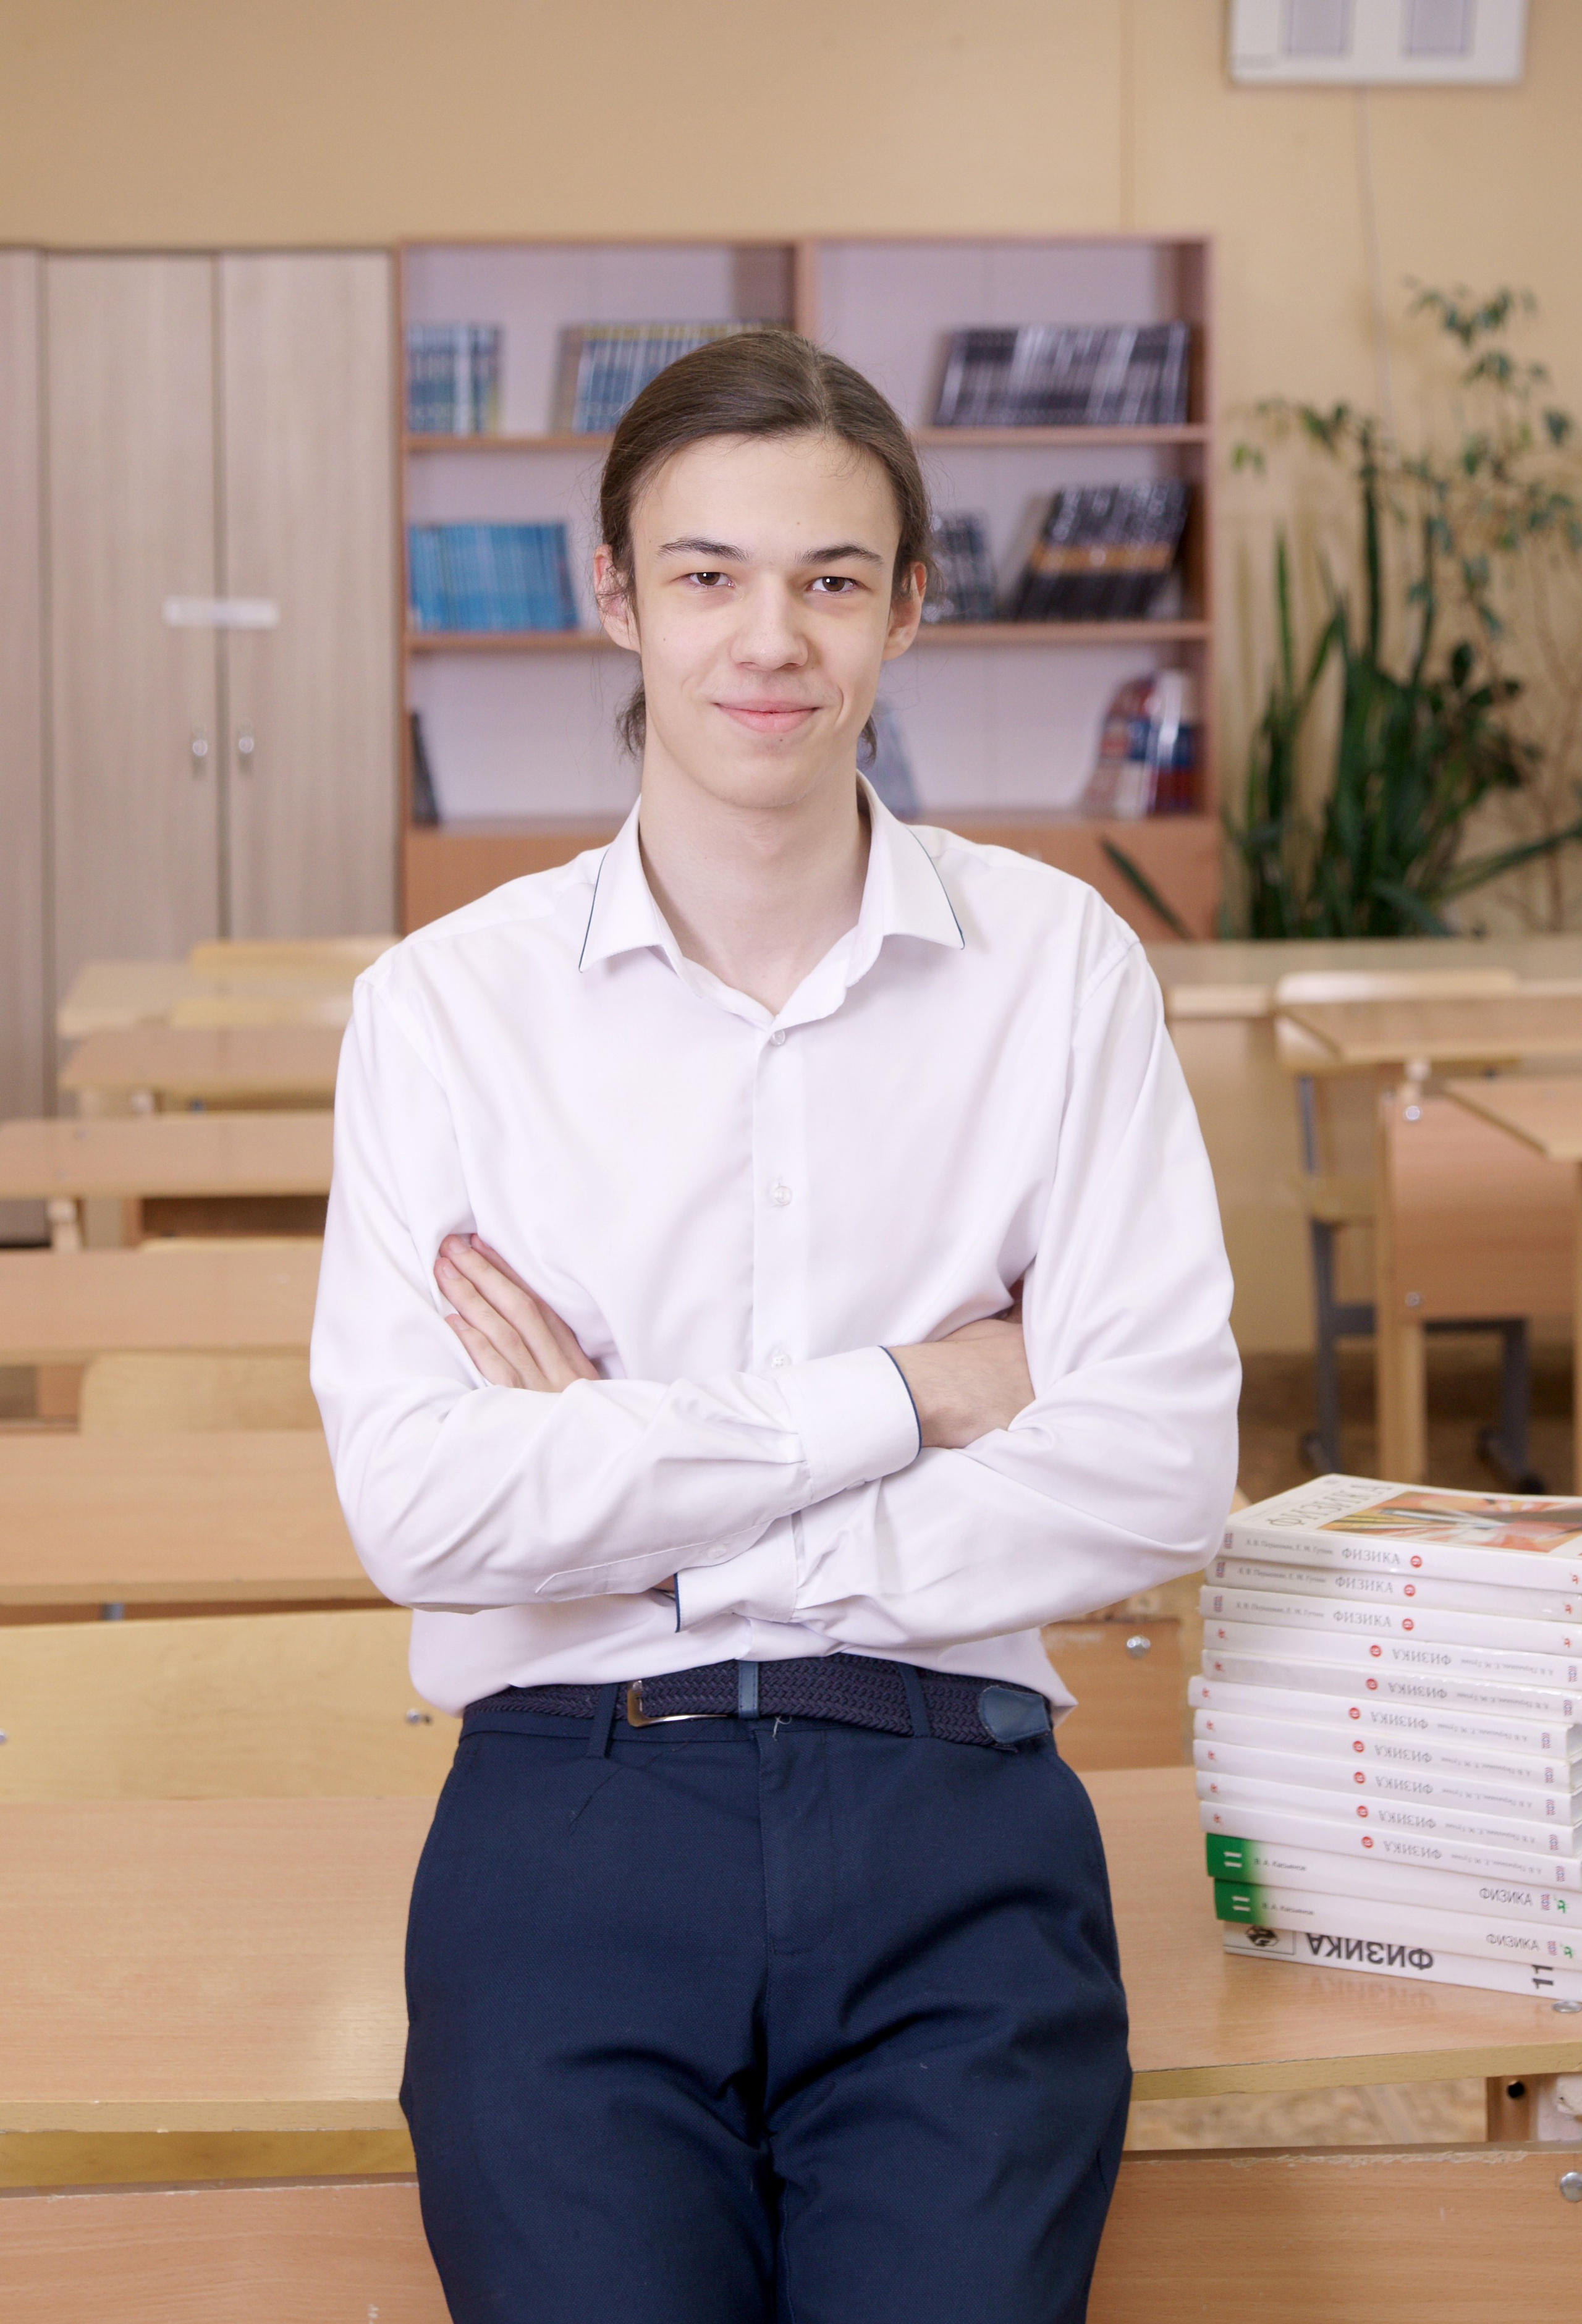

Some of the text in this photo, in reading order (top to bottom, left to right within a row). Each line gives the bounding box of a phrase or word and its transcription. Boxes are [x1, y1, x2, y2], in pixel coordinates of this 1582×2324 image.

[1267, 1484, 1393, 1527] ФИЗИКА
[1342, 1548, 1400, 1565] ФИЗИКА
[1335, 1576, 1394, 1594] ФИЗИКА
[1332, 1610, 1392, 1628] ФИЗИКА
[1392, 1648, 1452, 1666] ФИЗИКА
[1388, 1682, 1448, 1700] ФИЗИКА
[1371, 1711, 1429, 1730] ФИЗИКА
[1374, 1744, 1432, 1764] ФИЗИКА
[1376, 1776, 1433, 1794] ФИЗИКА
[1379, 1809, 1437, 1829] ФИЗИКА
[1383, 1840, 1442, 1860] ФИЗИКА
[1223, 1851, 1242, 1868] 11
[1479, 1888, 1533, 1906] ФИЗИКА
[1231, 1896, 1251, 1912] 11
[1486, 1933, 1540, 1951] ФИЗИКА
[1305, 1933, 1554, 1989] ФИЗИКА 11
